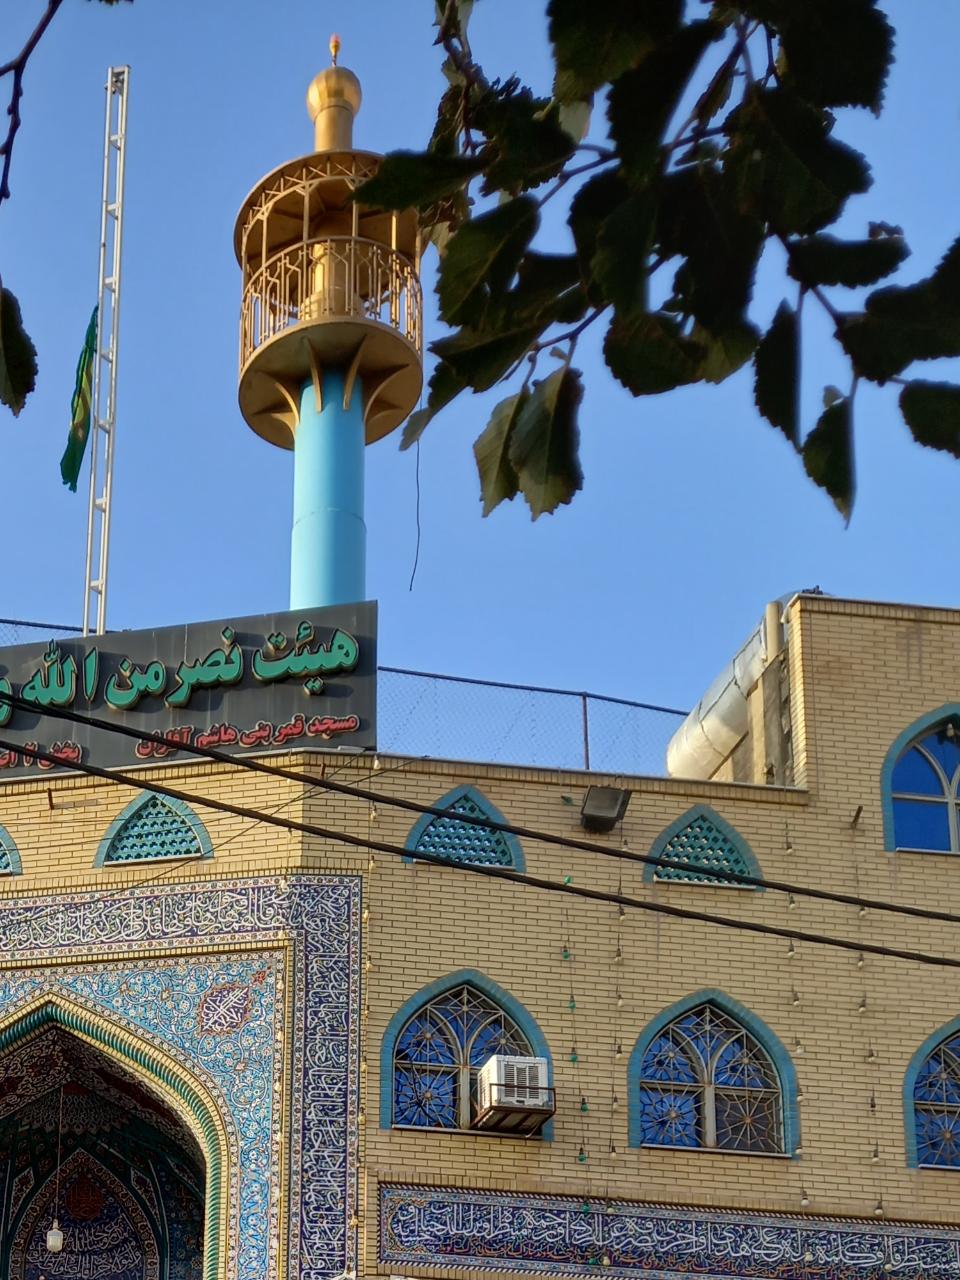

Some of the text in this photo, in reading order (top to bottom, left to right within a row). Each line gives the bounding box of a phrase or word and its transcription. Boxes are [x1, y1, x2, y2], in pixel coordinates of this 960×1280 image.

[165, 626, 243, 708] نصر
[104, 657, 167, 711] من
[194, 723, 239, 748] هاشم
[273, 713, 305, 745] قمر
[306, 714, 360, 740] مسجد
